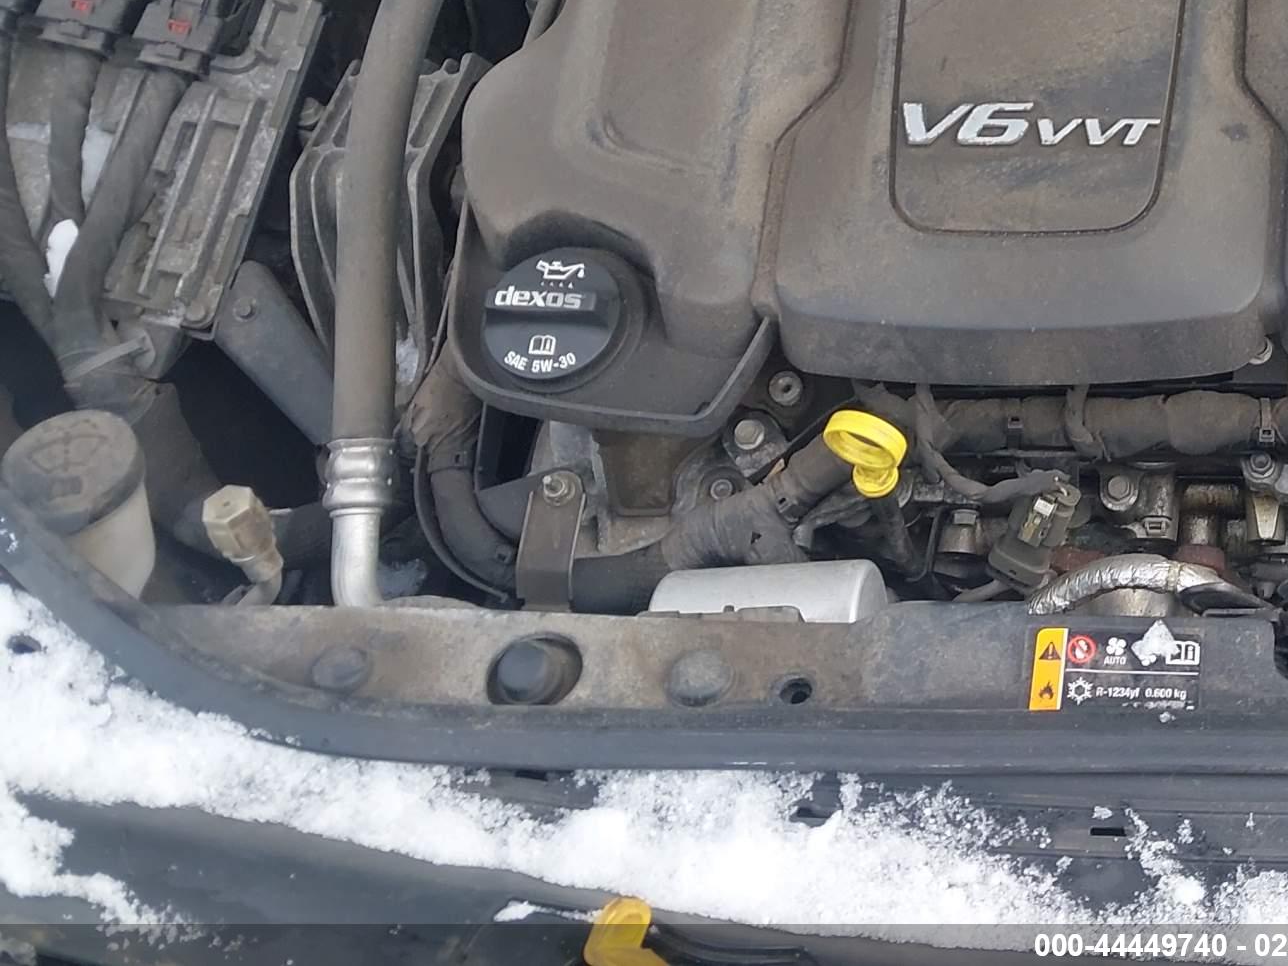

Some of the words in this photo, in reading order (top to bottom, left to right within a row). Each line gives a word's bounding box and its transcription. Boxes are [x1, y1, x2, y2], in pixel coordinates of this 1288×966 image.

[903, 102, 1034, 146] V6
[1037, 118, 1161, 146] VVT
[494, 285, 583, 309] dexos
[504, 351, 528, 371] SAE
[531, 352, 576, 373] 5W-30
[1103, 655, 1127, 665] AUTO
[1095, 687, 1140, 700] R-1234yf
[1174, 688, 1187, 700] kg
